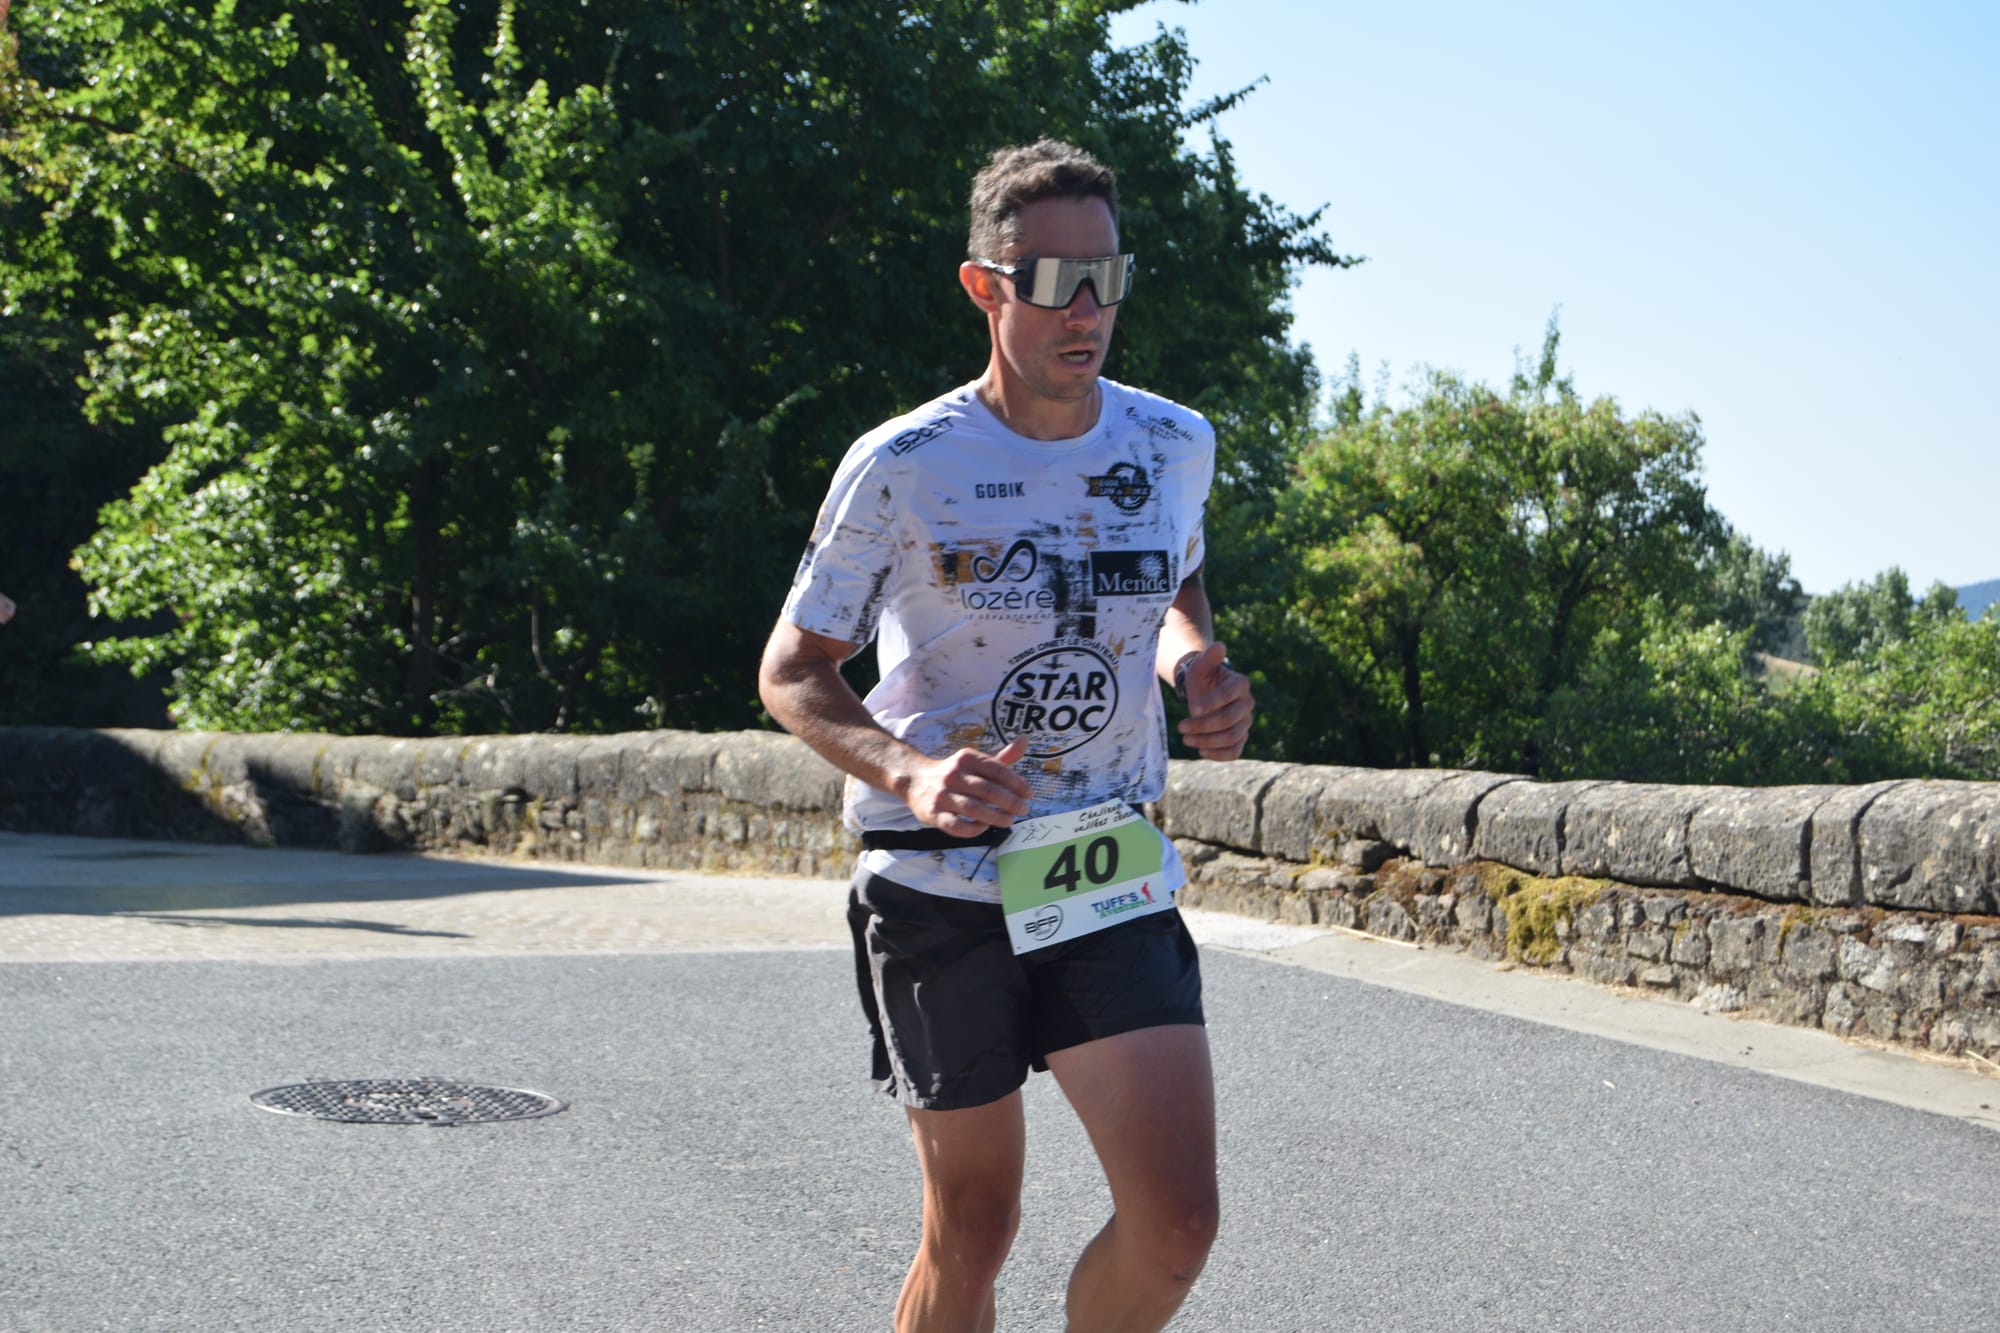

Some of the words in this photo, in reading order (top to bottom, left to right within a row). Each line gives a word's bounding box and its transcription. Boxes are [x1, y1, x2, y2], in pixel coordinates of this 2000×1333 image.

[975, 481, 1025, 499] GOBIK
[1097, 570, 1168, 592] Mende
[961, 587, 1056, 610] lozère
[1013, 671, 1107, 701] STAR
[1003, 700, 1107, 732] TROC
[1043, 836, 1119, 893] 40
[1091, 892, 1139, 912] TUFF'S
